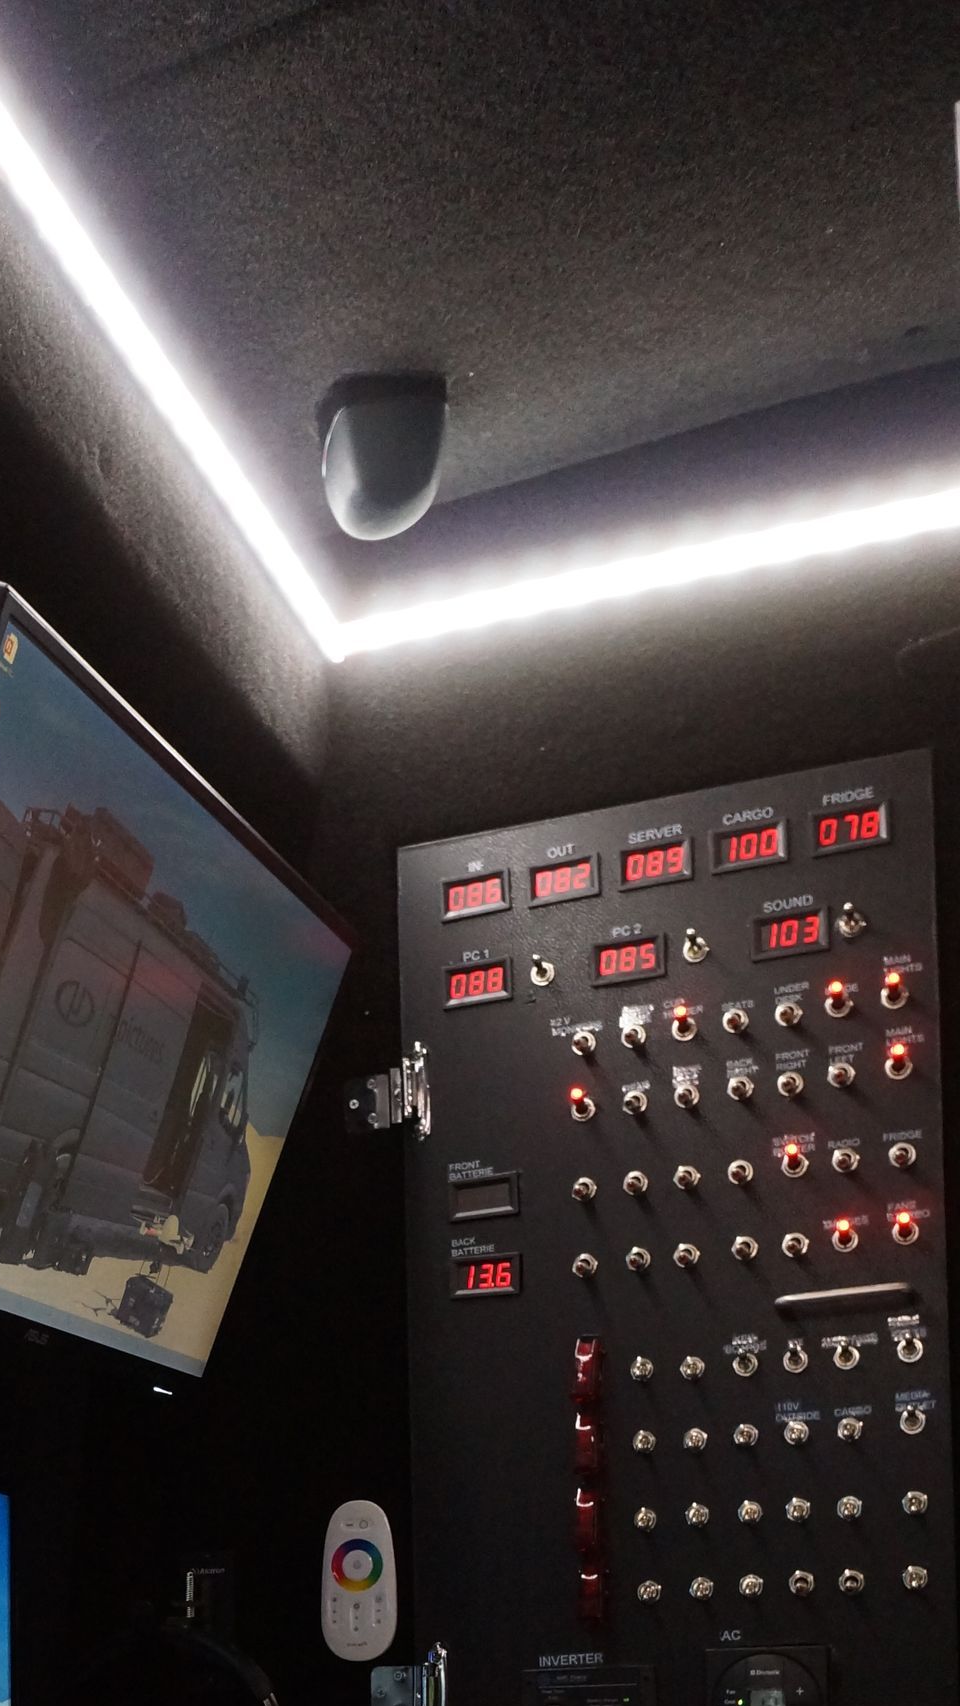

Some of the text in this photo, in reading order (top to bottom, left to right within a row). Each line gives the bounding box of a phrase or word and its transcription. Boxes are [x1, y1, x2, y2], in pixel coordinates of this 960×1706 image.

[822, 787, 875, 806] FRIDGE
[722, 807, 774, 825] CARGO
[628, 824, 682, 844] SERVER
[819, 811, 880, 846] 078
[547, 845, 575, 859] OUT
[729, 828, 778, 863] 100
[626, 847, 684, 881] 089
[535, 863, 590, 897] 082
[448, 879, 502, 911] 086
[763, 894, 814, 913] SOUND
[612, 923, 642, 938] PC 2
[770, 916, 820, 948] 103
[462, 951, 480, 962] PC
[600, 943, 655, 976] 085
[450, 967, 504, 999] 088
[774, 981, 810, 994] UNDER
[885, 1026, 912, 1036] MAIN
[776, 1049, 810, 1061] FRONT
[828, 1042, 864, 1055] FRONT
[776, 1060, 807, 1071] RIGHT
[883, 1129, 923, 1141] FRIDGE
[828, 1138, 860, 1149] RADIO
[449, 1160, 480, 1170] FRONT
[449, 1167, 494, 1181] BATTERIE
[451, 1237, 475, 1247] BACK
[451, 1244, 495, 1257] BATTERIE
[467, 1262, 511, 1289] 13.6
[721, 1630, 741, 1641] AC
[539, 1653, 604, 1667] INVERTER
